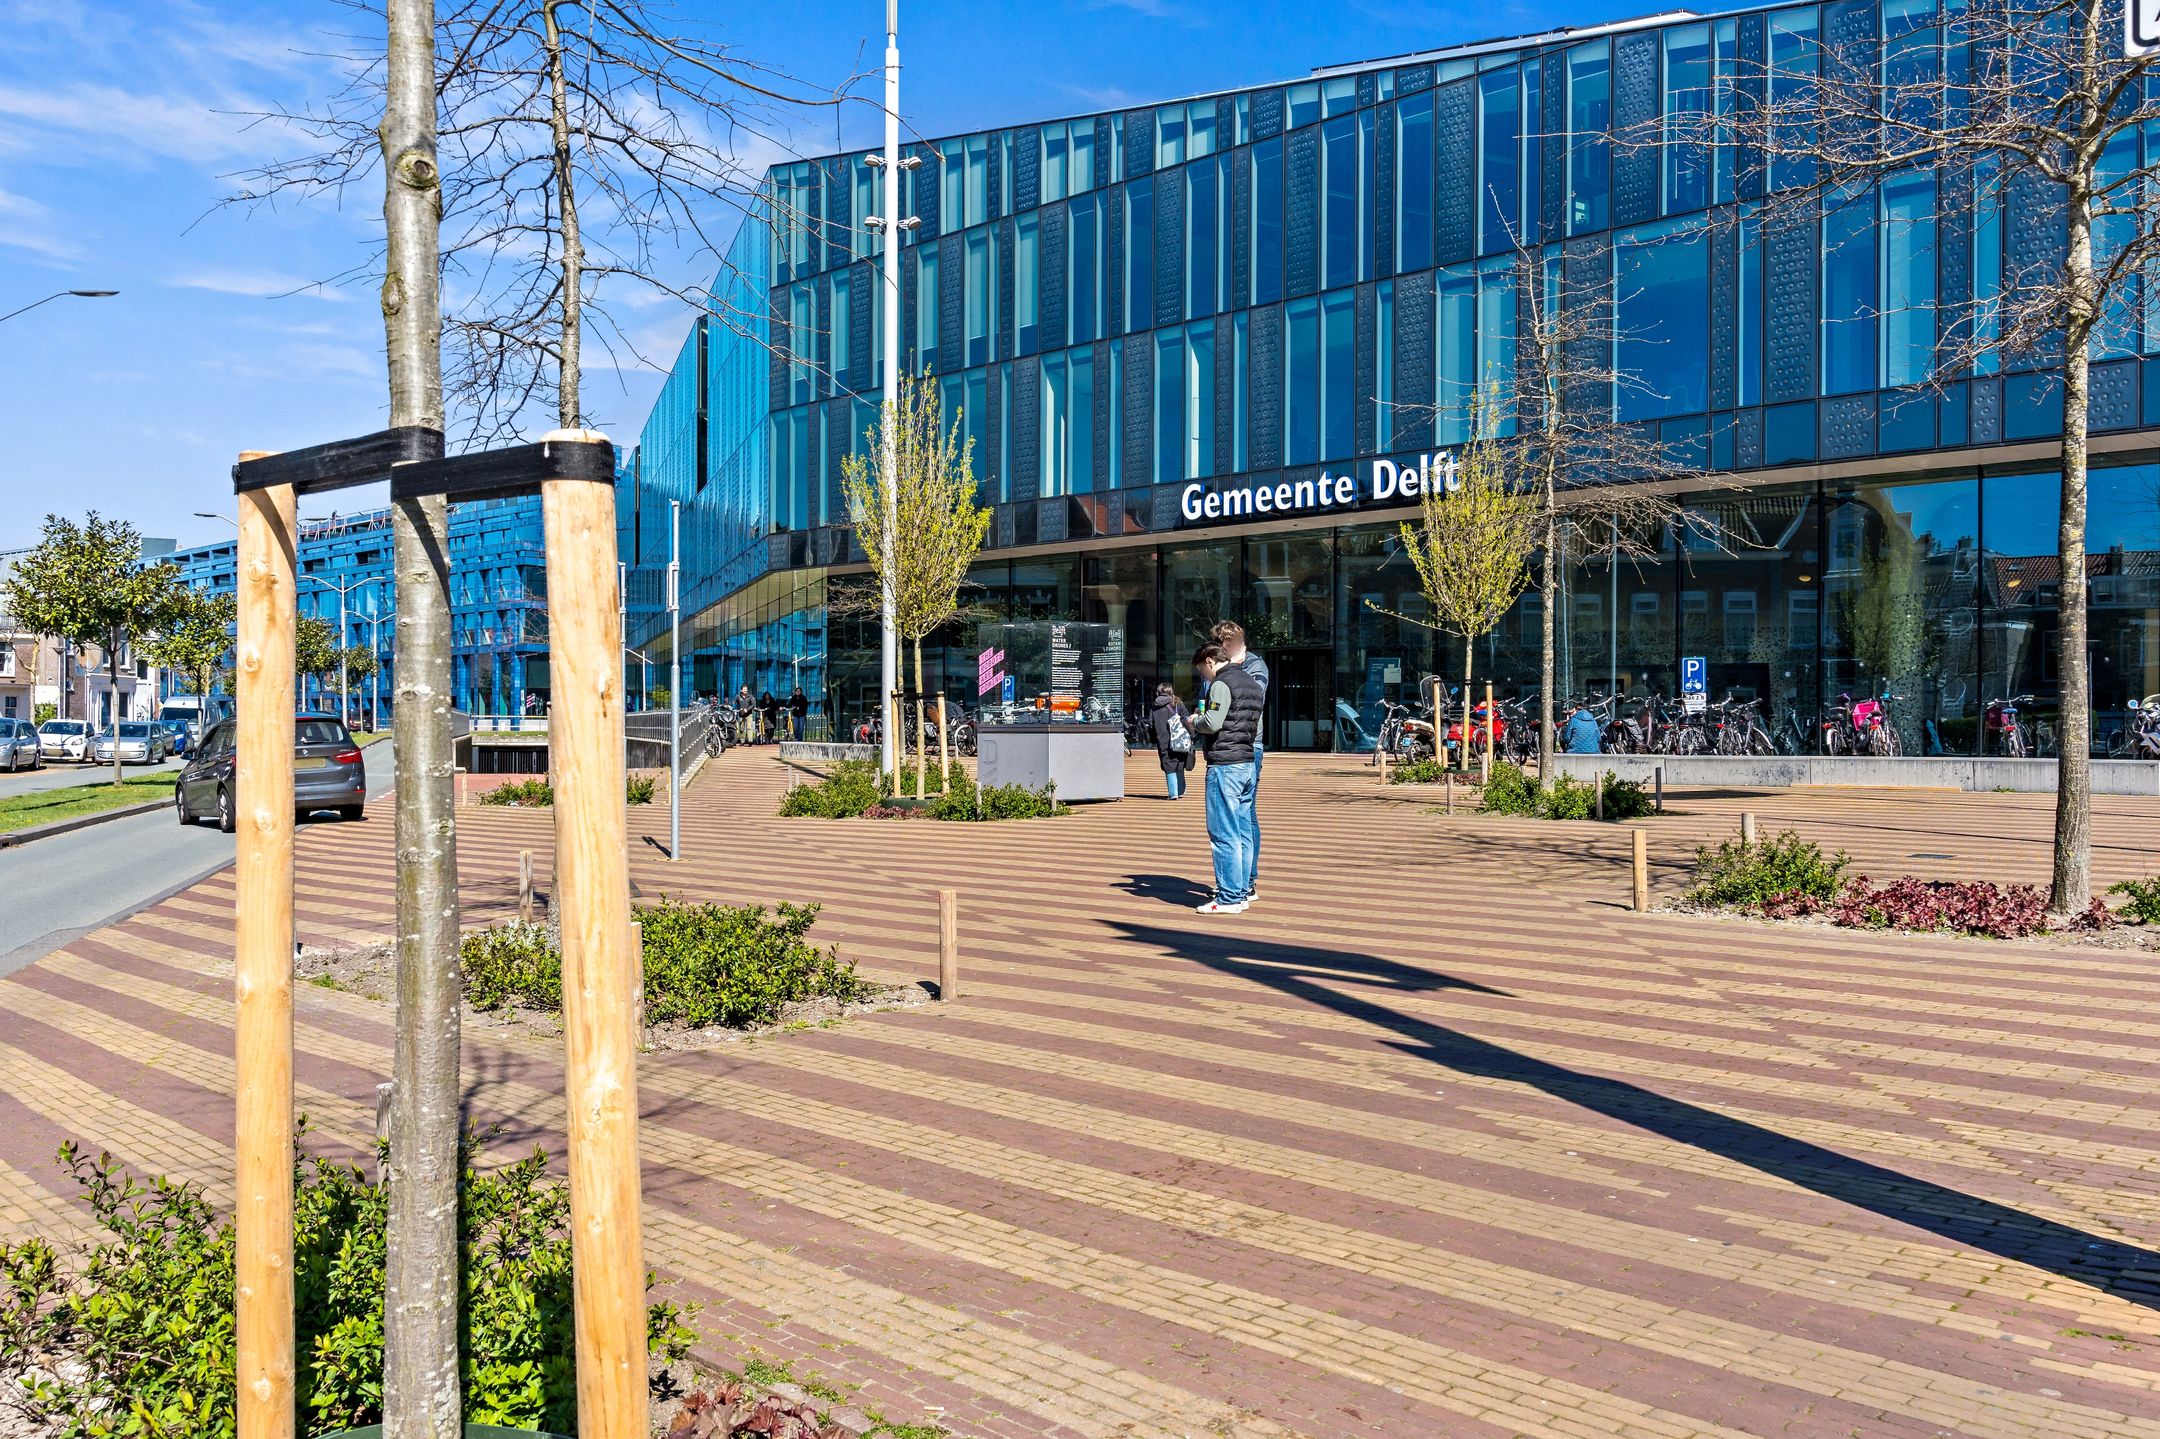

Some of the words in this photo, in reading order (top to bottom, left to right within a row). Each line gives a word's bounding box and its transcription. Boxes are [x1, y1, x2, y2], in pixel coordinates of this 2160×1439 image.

[1182, 471, 1353, 520] Gemeente
[1373, 451, 1460, 500] Delft
[980, 649, 992, 661] THE
[980, 652, 1003, 671] ROBOTS
[980, 670, 992, 682] ARE
[1687, 660, 1700, 678] P
[980, 672, 1003, 693] COMING
[1004, 678, 1011, 691] P
